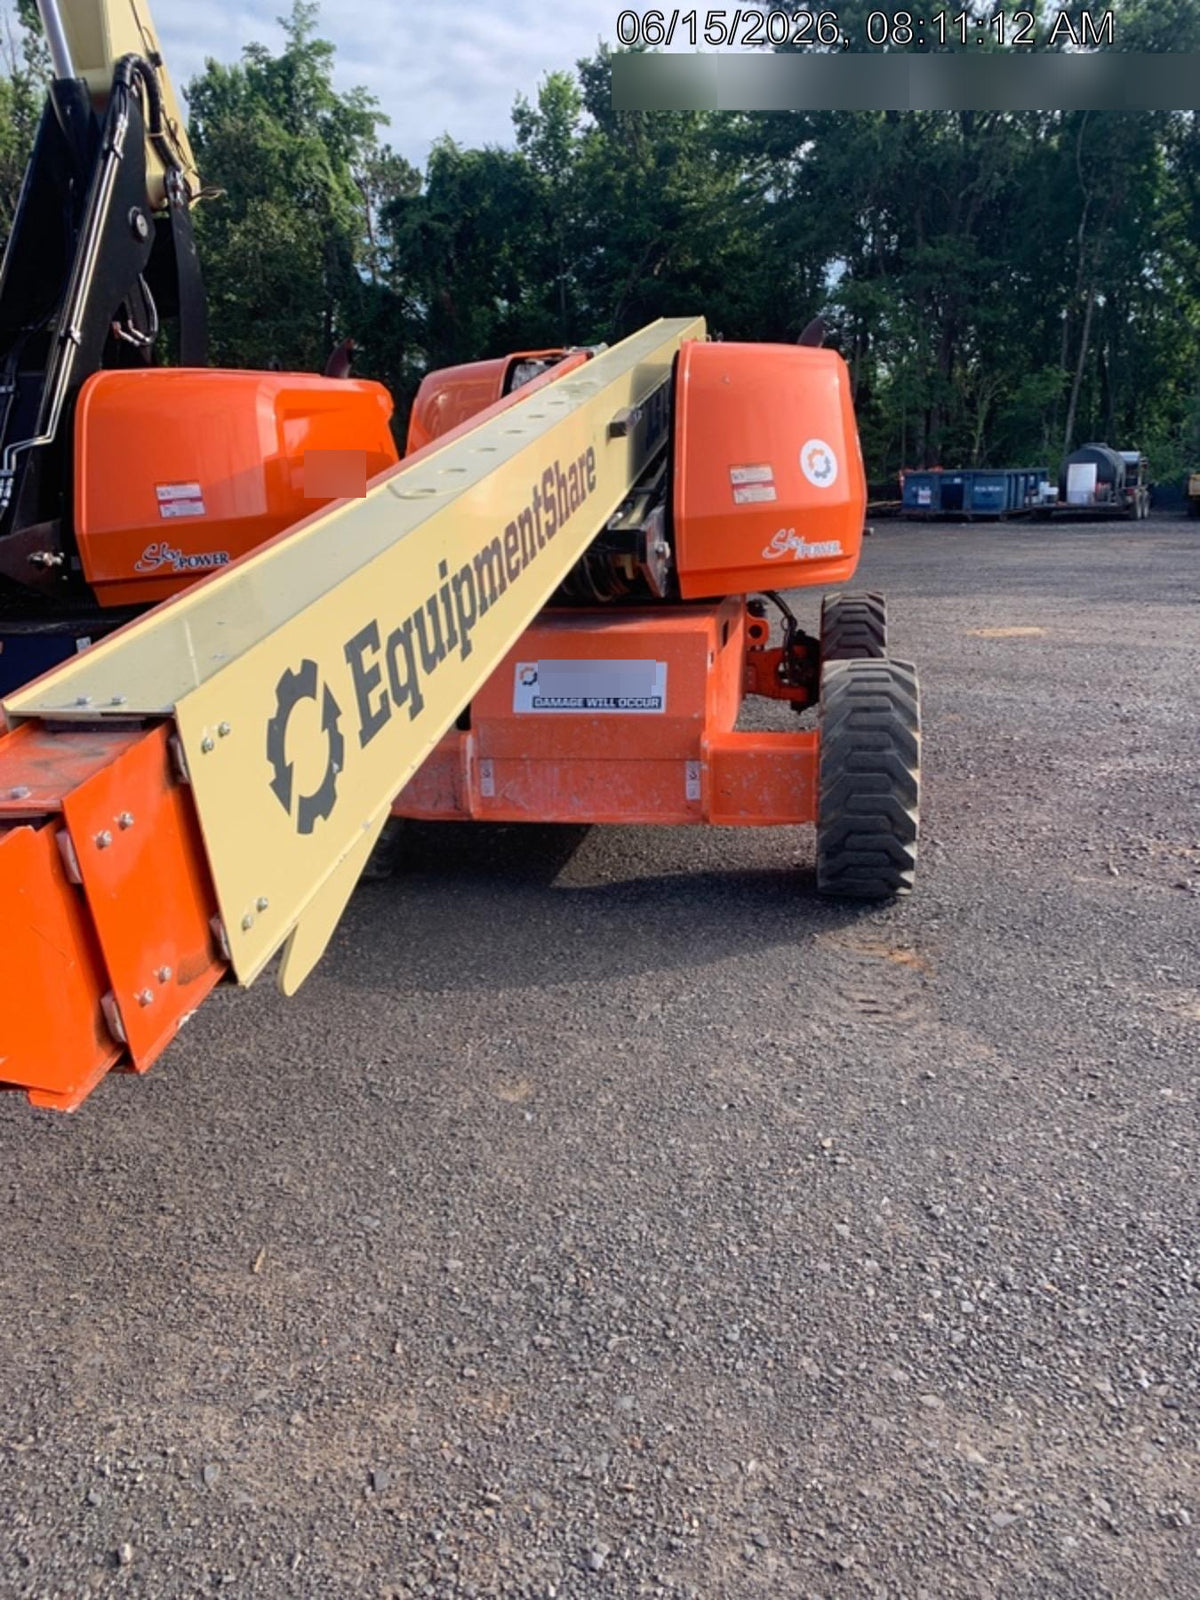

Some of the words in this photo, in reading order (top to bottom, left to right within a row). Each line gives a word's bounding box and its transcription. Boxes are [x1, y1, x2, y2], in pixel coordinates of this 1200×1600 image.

[135, 542, 182, 573] Sky
[176, 551, 230, 570] POWER
[344, 444, 597, 747] EquipmentShare
[534, 697, 583, 708] DAMAGE
[587, 697, 616, 708] WILL
[618, 697, 660, 708] OCCUR
